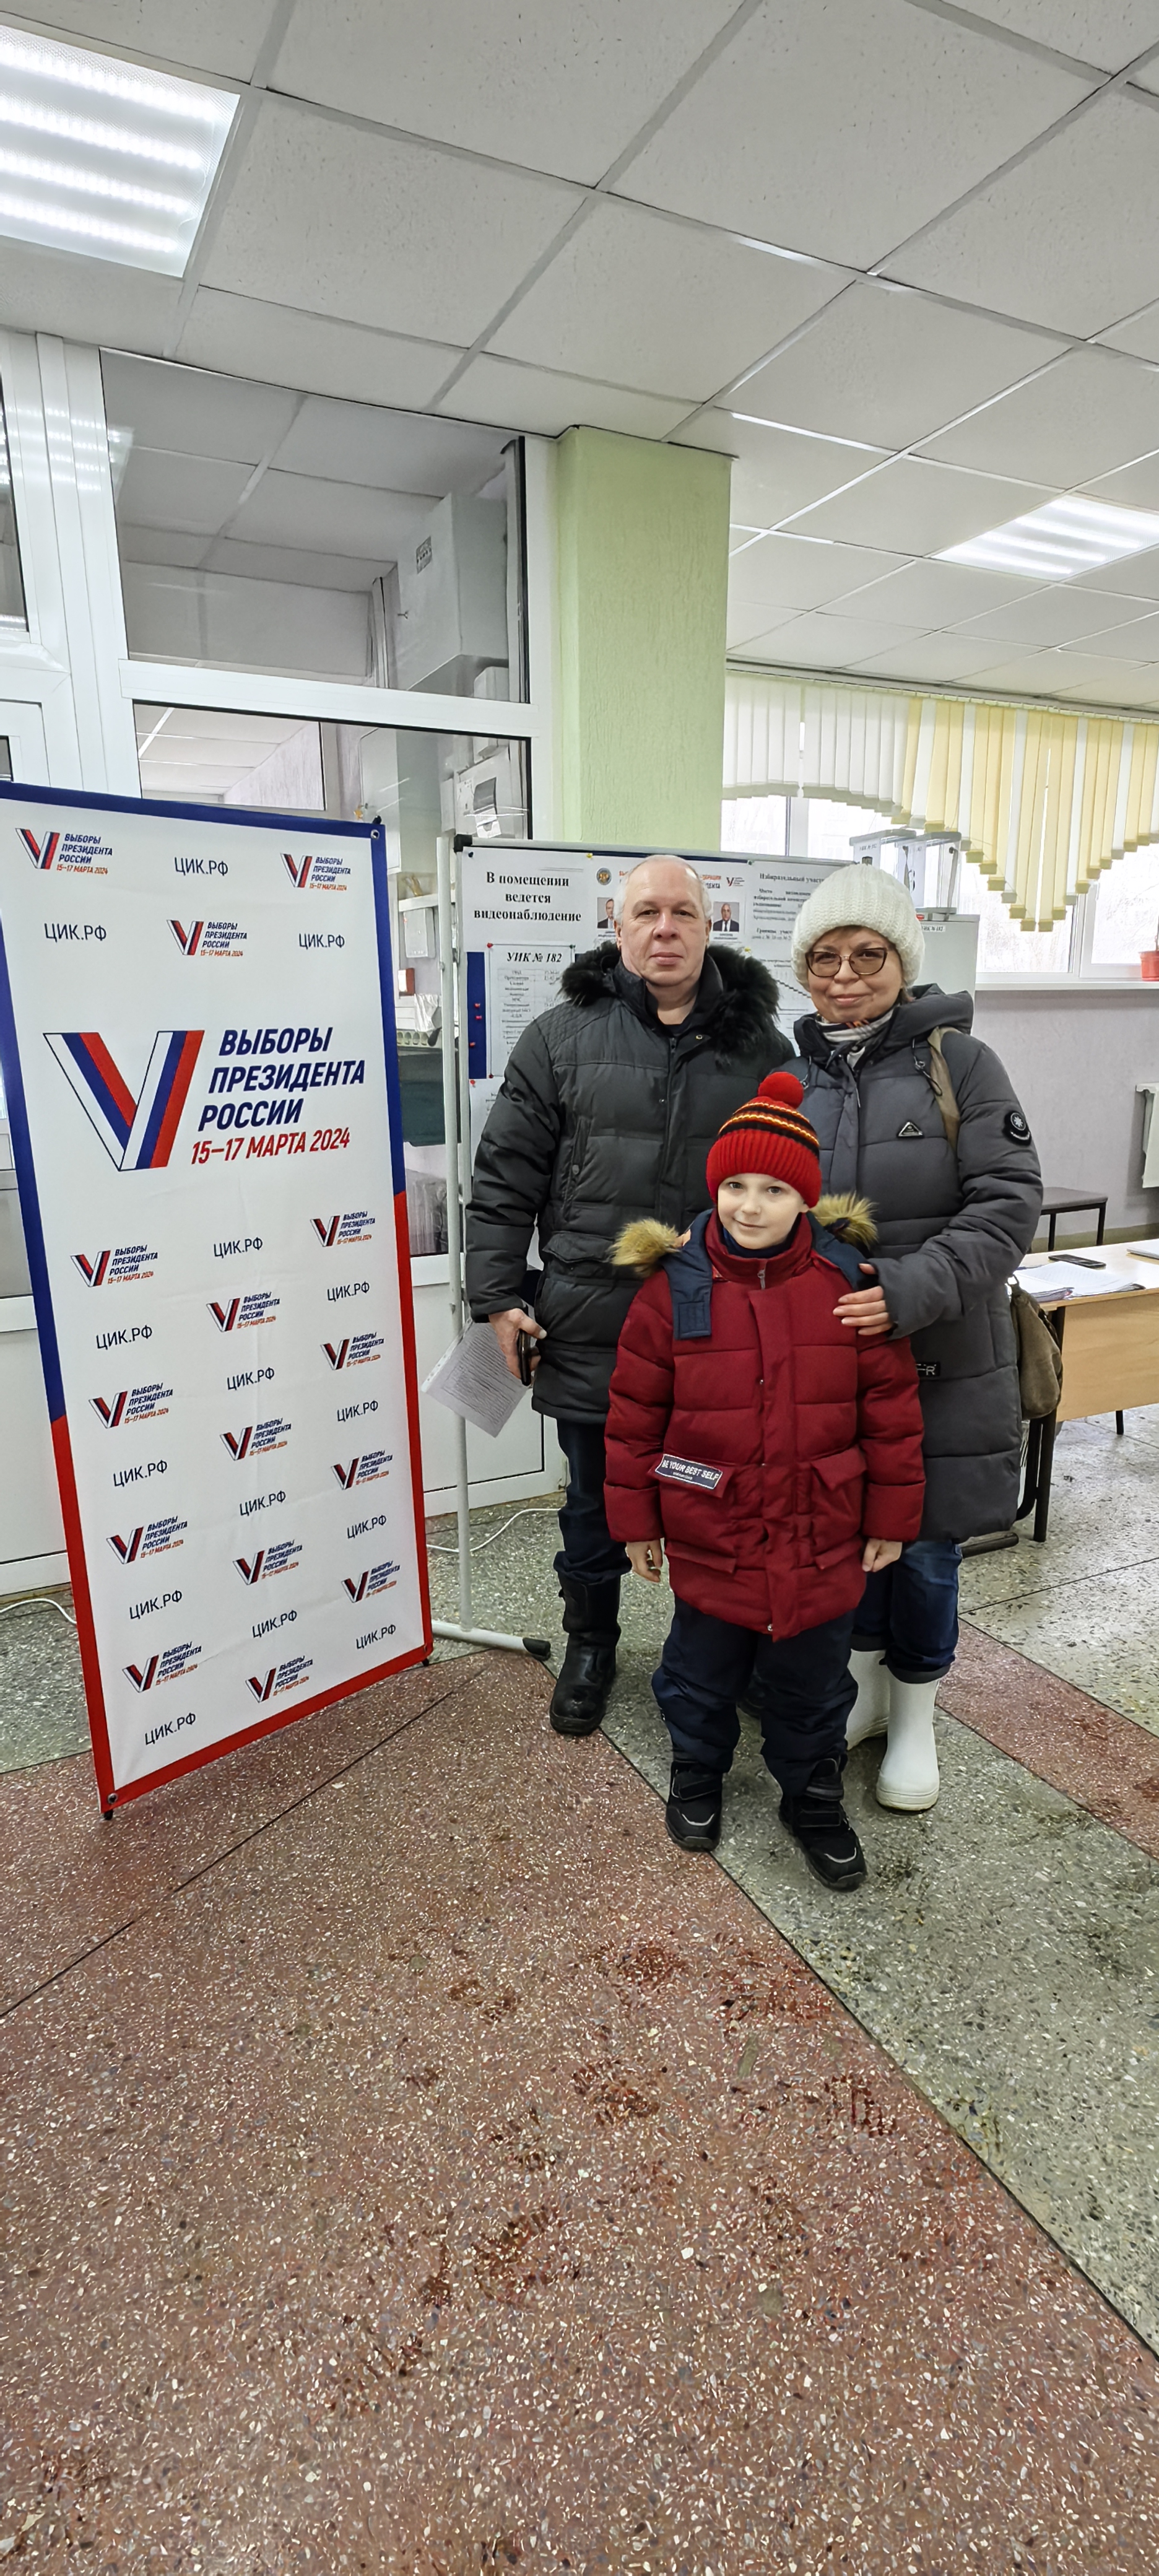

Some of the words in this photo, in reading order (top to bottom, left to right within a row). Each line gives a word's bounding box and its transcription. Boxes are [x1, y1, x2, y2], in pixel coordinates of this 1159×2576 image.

[64, 833, 101, 844] ВЫБОРЫ
[61, 843, 112, 855] ПРЕЗИДЕНТА
[58, 854, 92, 864] РОССИИ
[175, 858, 228, 876] ЦИК.РФ
[487, 871, 495, 884] В
[499, 875, 569, 887] помещении
[505, 894, 551, 903] ведется
[474, 909, 581, 921] видеонаблюдение
[45, 923, 106, 942] ЦИК.РФ
[207, 922, 238, 930] ВЫБОРЫ
[202, 940, 230, 948] РОССИИ
[299, 933, 344, 949] ЦИК.РФ
[507, 952, 531, 962] УИК
[532, 953, 543, 962] №
[546, 954, 562, 962] 182
[220, 1027, 332, 1055] ВЫБОРЫ
[210, 1061, 364, 1092] ПРЕЗИДЕНТА
[199, 1099, 303, 1131] РОССИИ
[191, 1138, 244, 1164] 15–17
[247, 1132, 306, 1157] МАРТА
[310, 1128, 349, 1152] 2024
[115, 1245, 147, 1256] ВЫБОРЫ
[214, 1237, 263, 1258] ЦИК.РФ
[112, 1252, 157, 1266] ПРЕЗИДЕНТА
[109, 1264, 139, 1276] РОССИИ
[327, 1281, 369, 1302] ЦИК.РФ
[96, 1325, 152, 1349] ЦИК.РФ
[227, 1367, 274, 1390] ЦИК.РФ
[129, 1389, 173, 1406] ПРЕЗИДЕНТА
[131, 1383, 163, 1396] ВЫБОРЫ
[126, 1402, 155, 1416] РОССИИ
[337, 1400, 378, 1422] ЦИК.РФ
[113, 1460, 167, 1487] ЦИК.РФ
[662, 1460, 669, 1468] BE
[669, 1461, 686, 1473] YOUR
[685, 1466, 702, 1476] BEST
[701, 1470, 719, 1481] SELF
[240, 1490, 285, 1516] ЦИК.РФ
[145, 1521, 187, 1541] ПРЕЗИДЕНТА
[147, 1516, 178, 1531] ВЫБОРЫ
[347, 1515, 386, 1538] ЦИК.РФ
[142, 1535, 170, 1551] РОССИИ
[129, 1590, 182, 1619] ЦИК.РФ
[252, 1610, 297, 1637] ЦИК.РФ
[356, 1624, 396, 1649] ЦИК.РФ
[145, 1713, 196, 1744] ЦИК.РФ
